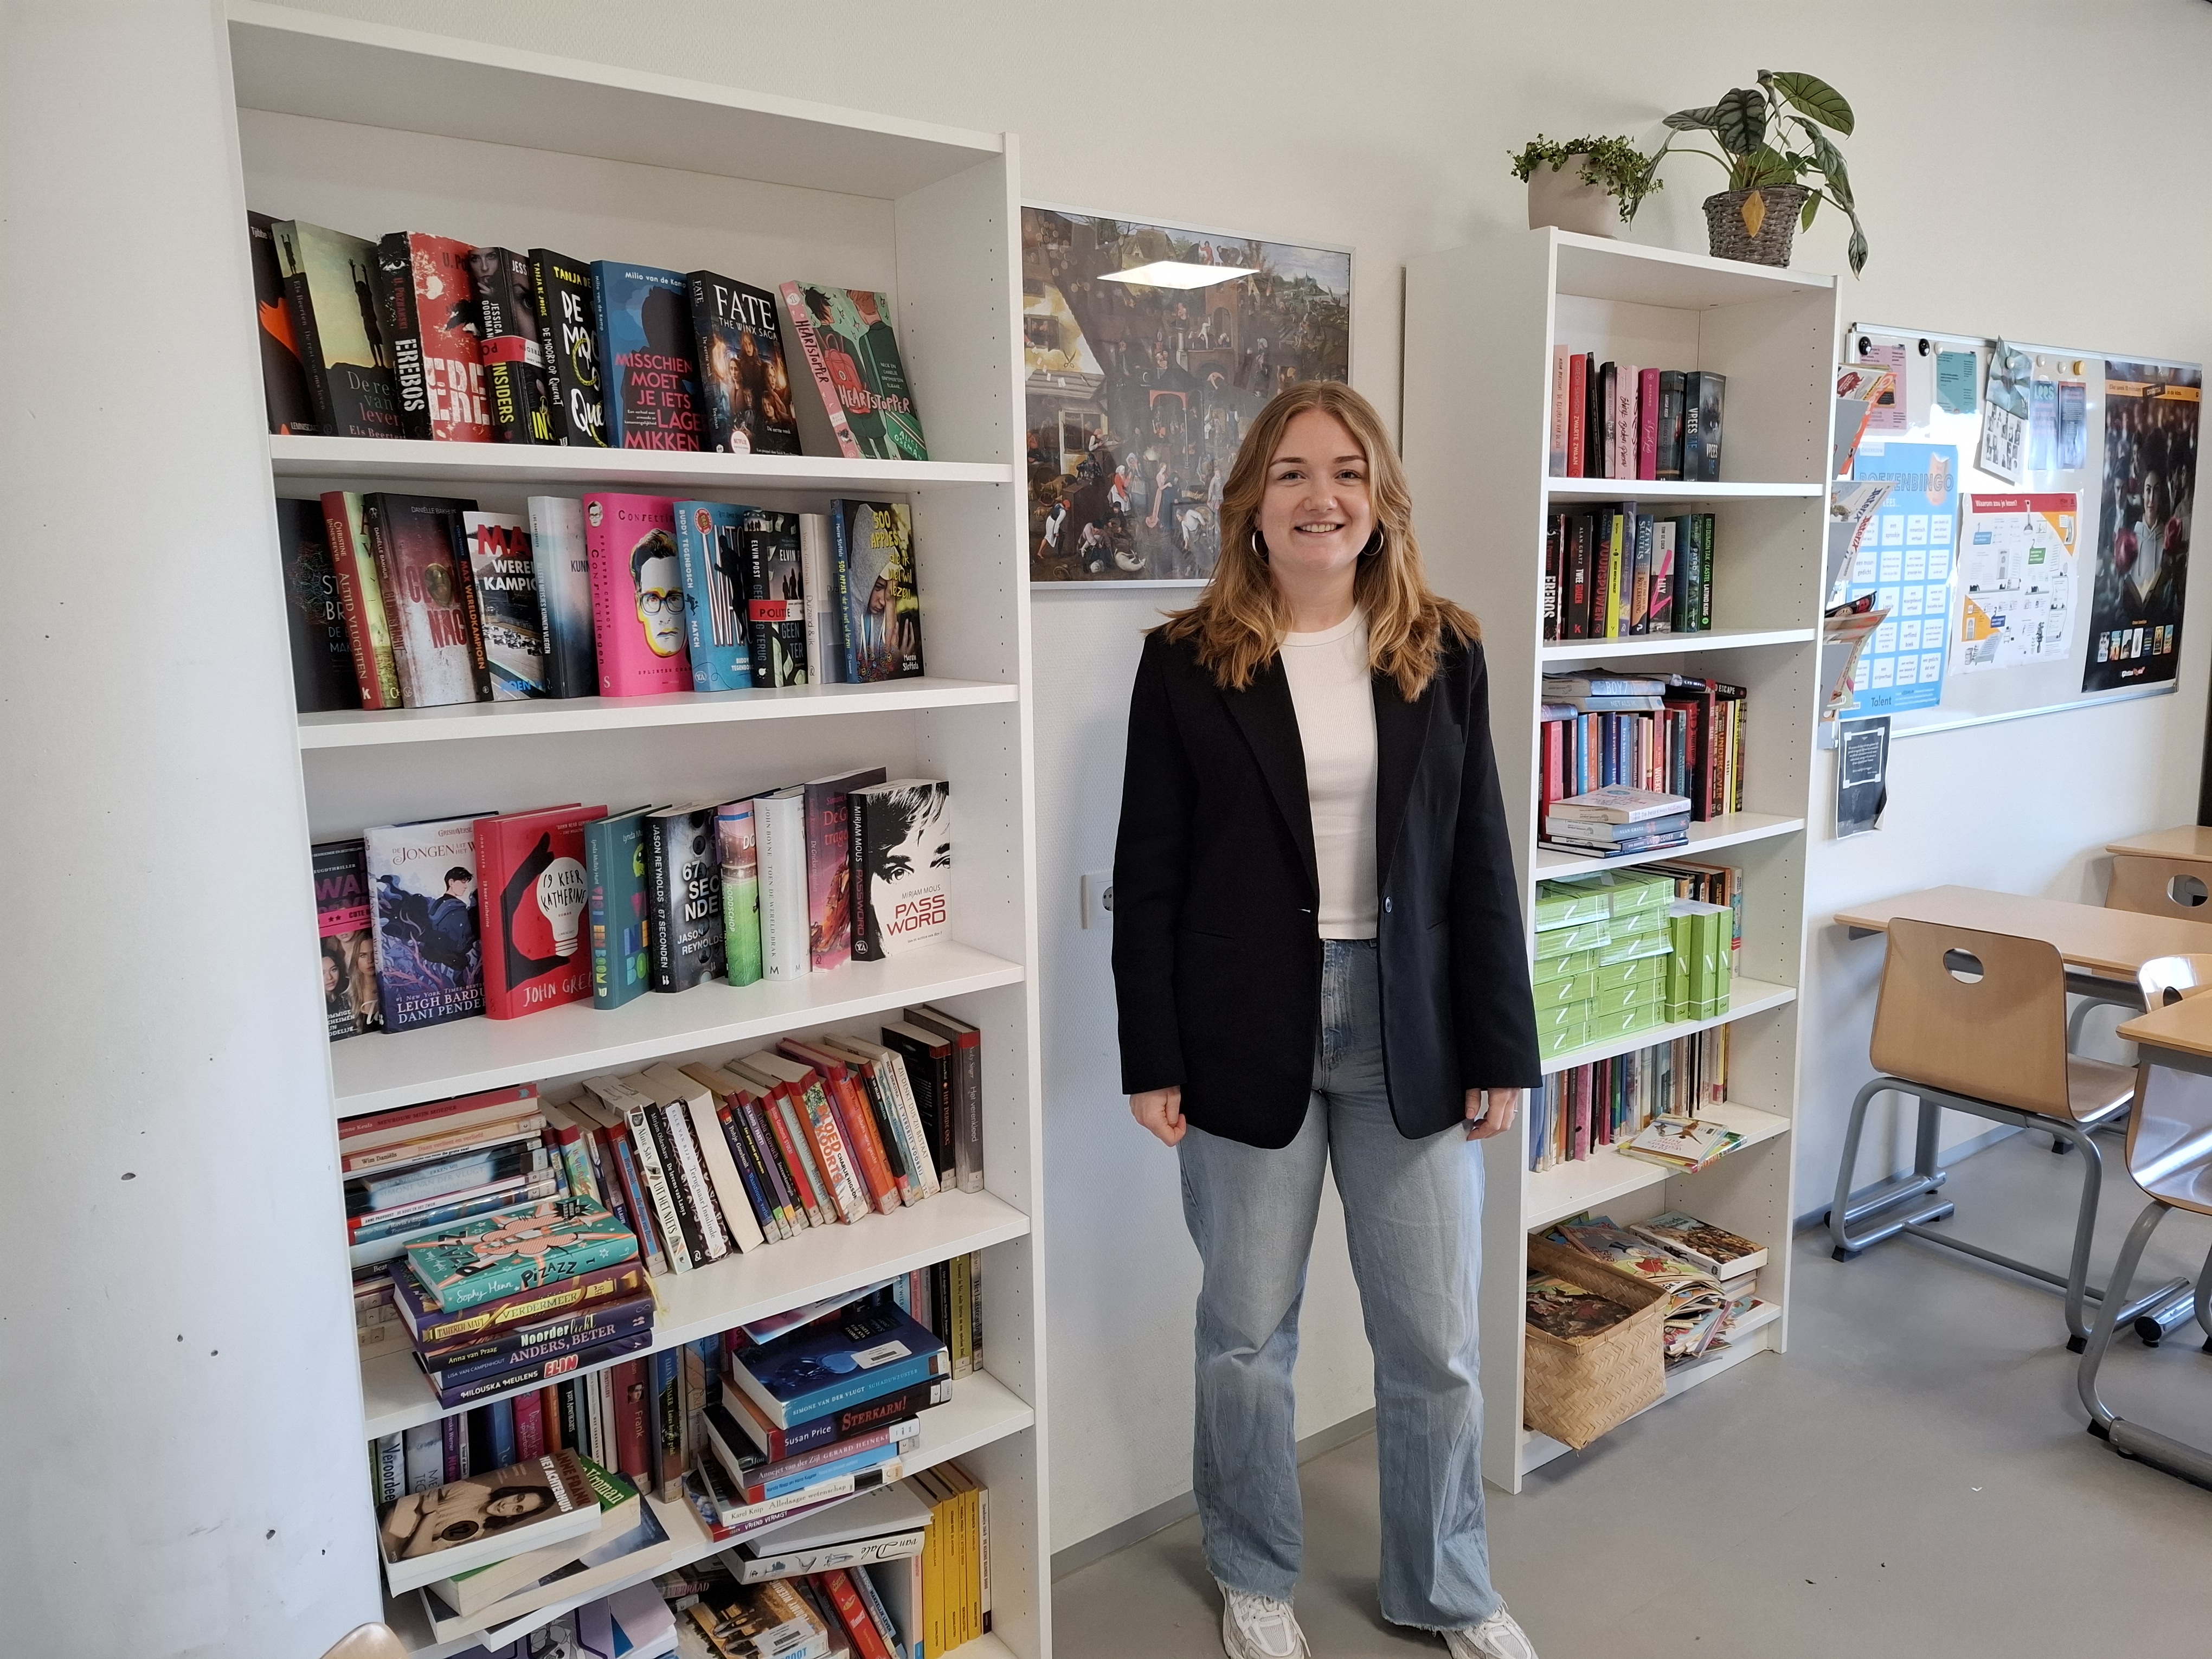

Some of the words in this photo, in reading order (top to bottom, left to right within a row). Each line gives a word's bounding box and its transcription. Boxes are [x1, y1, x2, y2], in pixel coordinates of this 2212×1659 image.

[625, 271, 644, 281] Milio
[660, 275, 669, 285] de
[670, 278, 687, 288] Kamp
[695, 280, 704, 304] FATE
[481, 300, 494, 338] GOODMAN
[490, 302, 503, 335] JESSICA
[561, 290, 584, 324] DE
[712, 284, 775, 331] FATE
[718, 317, 735, 330] THE
[736, 321, 757, 336] WINX
[758, 329, 778, 342] SAGA
[615, 353, 693, 373] MISSCHIEN
[795, 319, 829, 384] HEARTSTOPPER
[394, 338, 426, 412] EREBOS
[631, 371, 679, 390] MOET
[636, 389, 657, 406] JE
[661, 391, 692, 409] IETS
[838, 384, 911, 414] HEARTSTOPPER
[1687, 407, 1699, 434] VREES
[624, 430, 700, 452] MIKKEN
[733, 438, 748, 446] NETFLIX
[899, 430, 919, 451] ALICE
[1706, 443, 1718, 459] VREES
[1853, 487, 1883, 522] Asterix
[678, 509, 688, 537] BUDDY
[873, 510, 891, 530] 500
[333, 521, 347, 557] CHRISTINE
[871, 530, 900, 549] APPJES
[1637, 520, 1645, 560] SLEUTELS
[1643, 526, 1652, 554] ZEVEN
[1851, 516, 1872, 553] Asterix
[681, 538, 694, 589] TEGENBOSCH
[750, 539, 759, 563] ELVIN
[780, 549, 796, 562] ELVIN
[889, 553, 901, 565] die
[902, 554, 910, 567] ik
[459, 560, 471, 583] MAX
[752, 564, 760, 579] POST
[888, 567, 902, 582] niet
[903, 570, 913, 584] wil
[1575, 568, 1584, 584] TWEE
[1594, 539, 1610, 621] VUURSPUWEN
[890, 584, 911, 600] lezen
[1657, 578, 1667, 594] LILY
[759, 607, 791, 619] POLITIE
[339, 573, 354, 613] ALTIJD
[348, 615, 367, 679] VLUCHTEN
[464, 584, 486, 671] WERELDKAMPIOEN
[691, 620, 701, 648] MATCH
[781, 622, 800, 640] GEEN
[756, 634, 768, 662] TERUG
[903, 653, 917, 663] Maren
[902, 661, 919, 671] Stoffels
[1718, 684, 1735, 695] ESCAPE
[1870, 696, 1893, 708] Talent
[1716, 732, 1725, 800] UNDERCOVER
[853, 806, 863, 837] MIRJAM
[652, 824, 662, 854] JASON
[855, 837, 863, 863] MOUS
[543, 873, 553, 889] 19
[557, 869, 584, 888] KEER
[654, 855, 665, 903] REYNOLDS
[681, 860, 702, 882] 67
[539, 888, 588, 912] KATHERINE
[688, 874, 721, 901] SEC
[902, 888, 923, 901] MIRJAM
[923, 884, 941, 895] MOUS
[657, 909, 666, 920] 67
[726, 884, 736, 933] DOODSCHOP
[855, 869, 865, 937] PASSWORD
[895, 893, 946, 920] PASS
[886, 909, 947, 937] WORD
[658, 919, 669, 969] SECONDEN
[677, 929, 704, 946] JASON
[681, 932, 723, 957] REYNOLDS
[769, 965, 780, 975] M
[397, 996, 441, 1014] LEIGH
[443, 986, 486, 1005] BARDU
[522, 981, 557, 1008] JOHN
[398, 1008, 435, 1025] DANI
[637, 1128, 647, 1148] Aline
[816, 1104, 843, 1153] BLOED
[376, 1152, 398, 1162] Daniëls
[642, 1147, 653, 1162] Sax
[814, 1126, 844, 1184] KOORTS
[837, 1153, 849, 1178] CHARLIE
[672, 1109, 681, 1128] ELLE
[678, 1128, 686, 1143] VAN
[682, 1143, 692, 1161] RIJN
[689, 1165, 700, 1189] Terug
[696, 1187, 704, 1205] naar
[700, 1203, 717, 1239] Insulinde
[653, 1181, 665, 1198] UIT
[658, 1195, 671, 1213] HET
[663, 1211, 678, 1235] NIETS
[502, 1291, 578, 1320] VERDERMEER
[436, 1322, 466, 1339] TAHEREH
[467, 1318, 485, 1330] MAFI
[520, 1314, 596, 1348] Noorderlicht
[447, 1353, 466, 1365] Anna
[466, 1350, 479, 1360] van
[479, 1346, 498, 1358] Praag
[509, 1338, 570, 1365] ANDERS,
[571, 1323, 616, 1346] BETER
[447, 1371, 458, 1379] LISA
[459, 1368, 470, 1376] VAN
[470, 1358, 505, 1373] CAMPENHOUT
[460, 1382, 502, 1400] MILOUSKA
[502, 1369, 539, 1389] MEULENS
[543, 1354, 579, 1379] ELIN
[792, 1404, 817, 1416] SIMONE
[818, 1398, 830, 1408] VAN
[831, 1394, 844, 1403] DER
[844, 1386, 866, 1398] VLUGT
[868, 1368, 918, 1390] SCHADUWZUSTER
[635, 1410, 643, 1439] Frank
[785, 1433, 809, 1447] Susan
[811, 1425, 832, 1439] Price
[842, 1395, 908, 1432] STERKARM!
[539, 1455, 554, 1471] HET
[545, 1468, 573, 1513] ACHTERHUIS
[730, 1509, 748, 1520] Karel
[749, 1505, 764, 1516] Knip
[768, 1494, 806, 1510] Alledaagse
[807, 1483, 847, 1499] wetenschap
[744, 1518, 764, 1531] VRIEND
[764, 1510, 789, 1525] VERMIST
